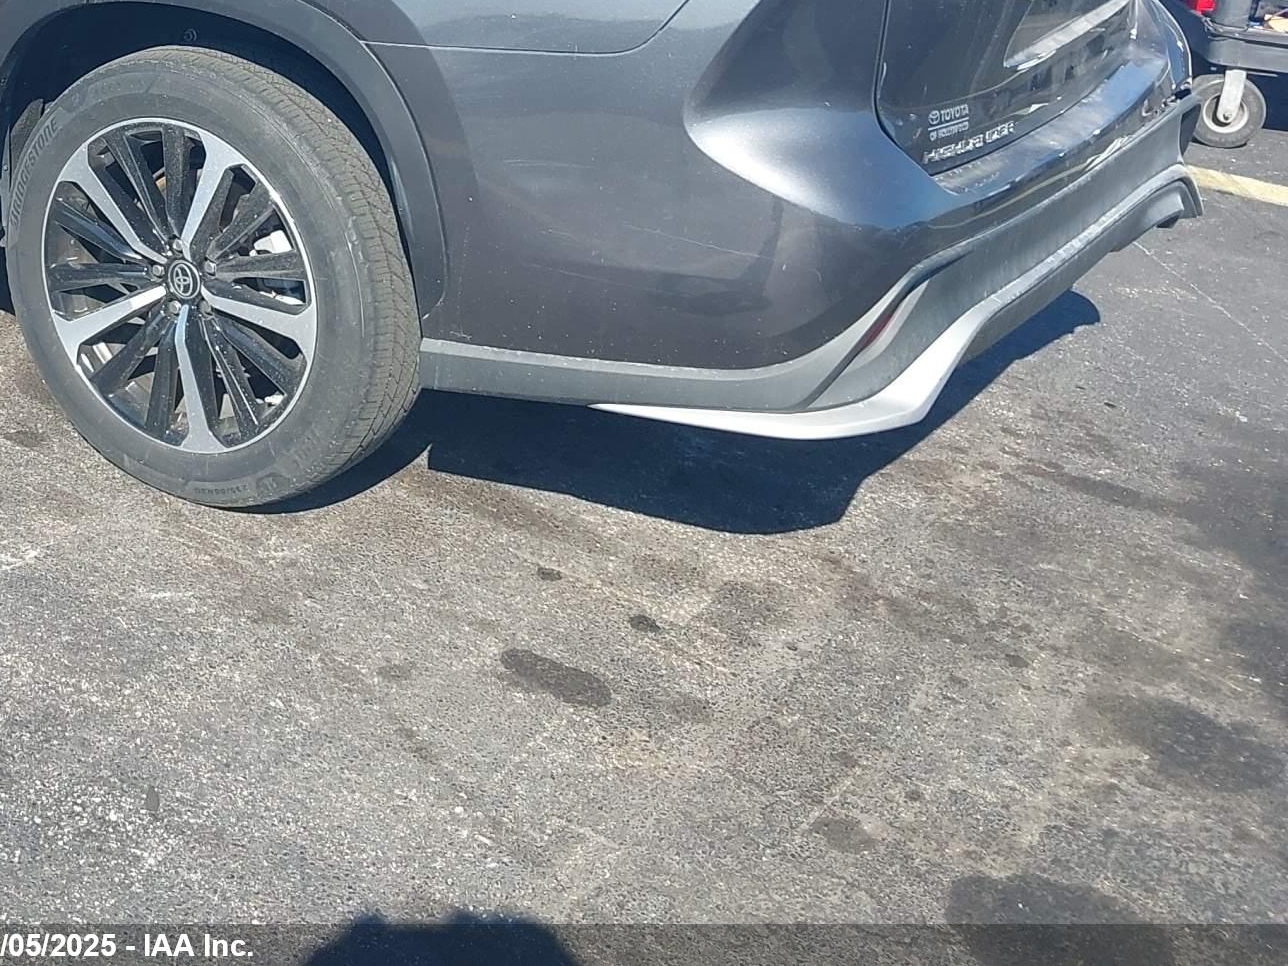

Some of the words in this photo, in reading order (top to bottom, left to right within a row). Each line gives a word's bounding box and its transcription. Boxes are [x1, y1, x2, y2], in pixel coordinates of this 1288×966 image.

[941, 104, 969, 123] TOYOTA
[922, 120, 1016, 165] HIGHLANDER
[9, 115, 58, 227] BRIDGESTONE
